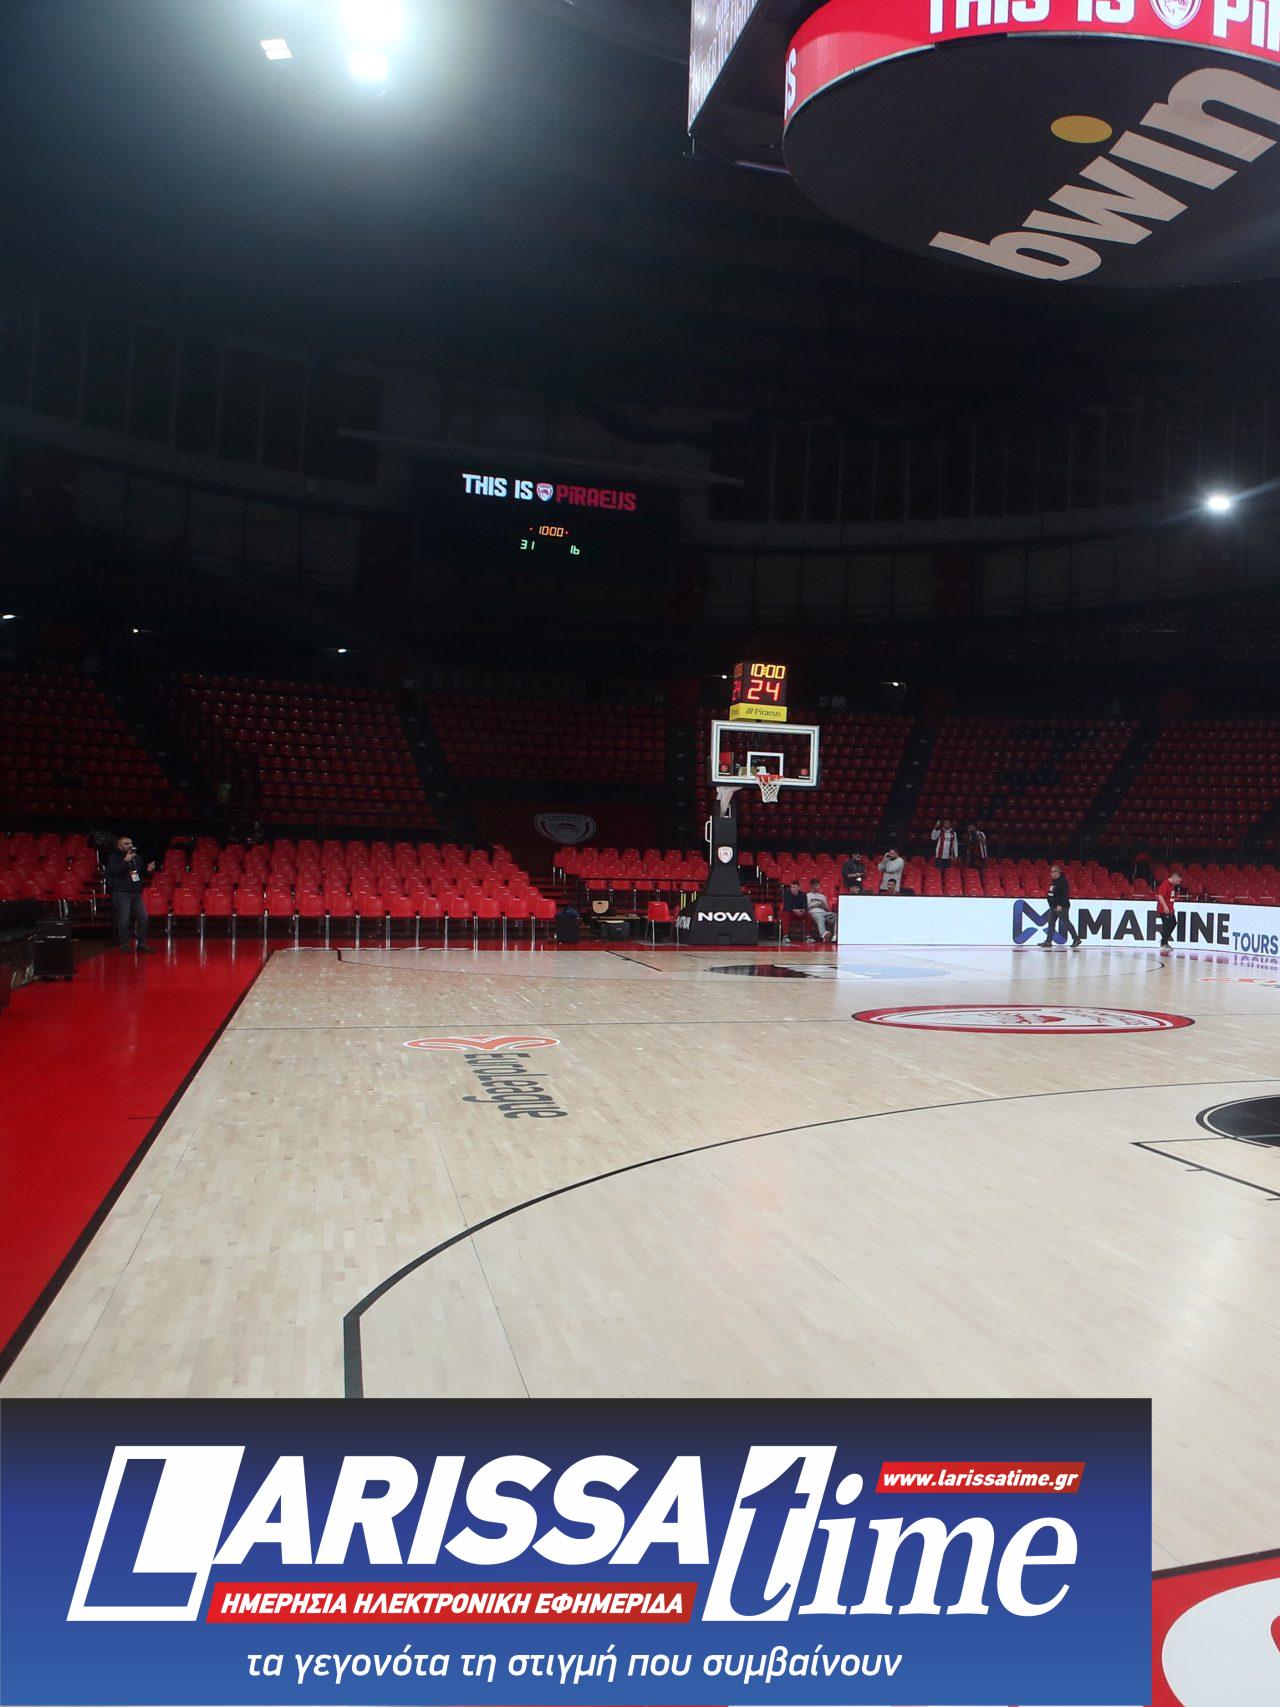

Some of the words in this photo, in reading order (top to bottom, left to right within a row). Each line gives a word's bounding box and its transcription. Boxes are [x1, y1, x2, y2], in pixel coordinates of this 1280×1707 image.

[462, 473, 508, 498] THIS
[514, 479, 534, 501] IS
[747, 679, 781, 701] 24
[698, 911, 752, 922] NOVA
[1232, 931, 1279, 956] TOURS
